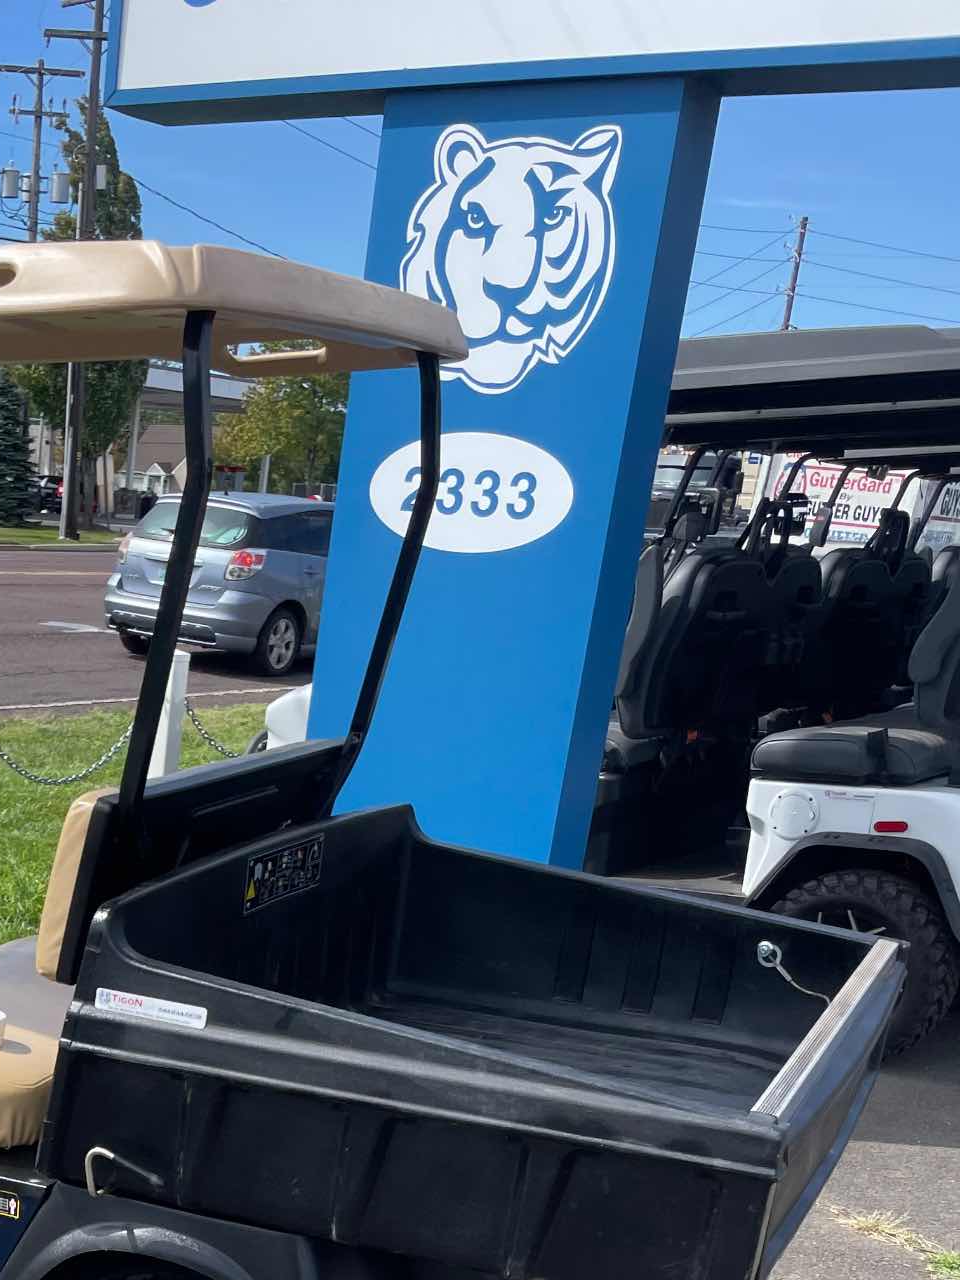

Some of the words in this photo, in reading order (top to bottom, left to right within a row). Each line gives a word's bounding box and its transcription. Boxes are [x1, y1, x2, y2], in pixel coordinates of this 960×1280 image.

[400, 466, 537, 520] 2333
[809, 471, 894, 495] GuterGard
[853, 503, 882, 523] GUY
